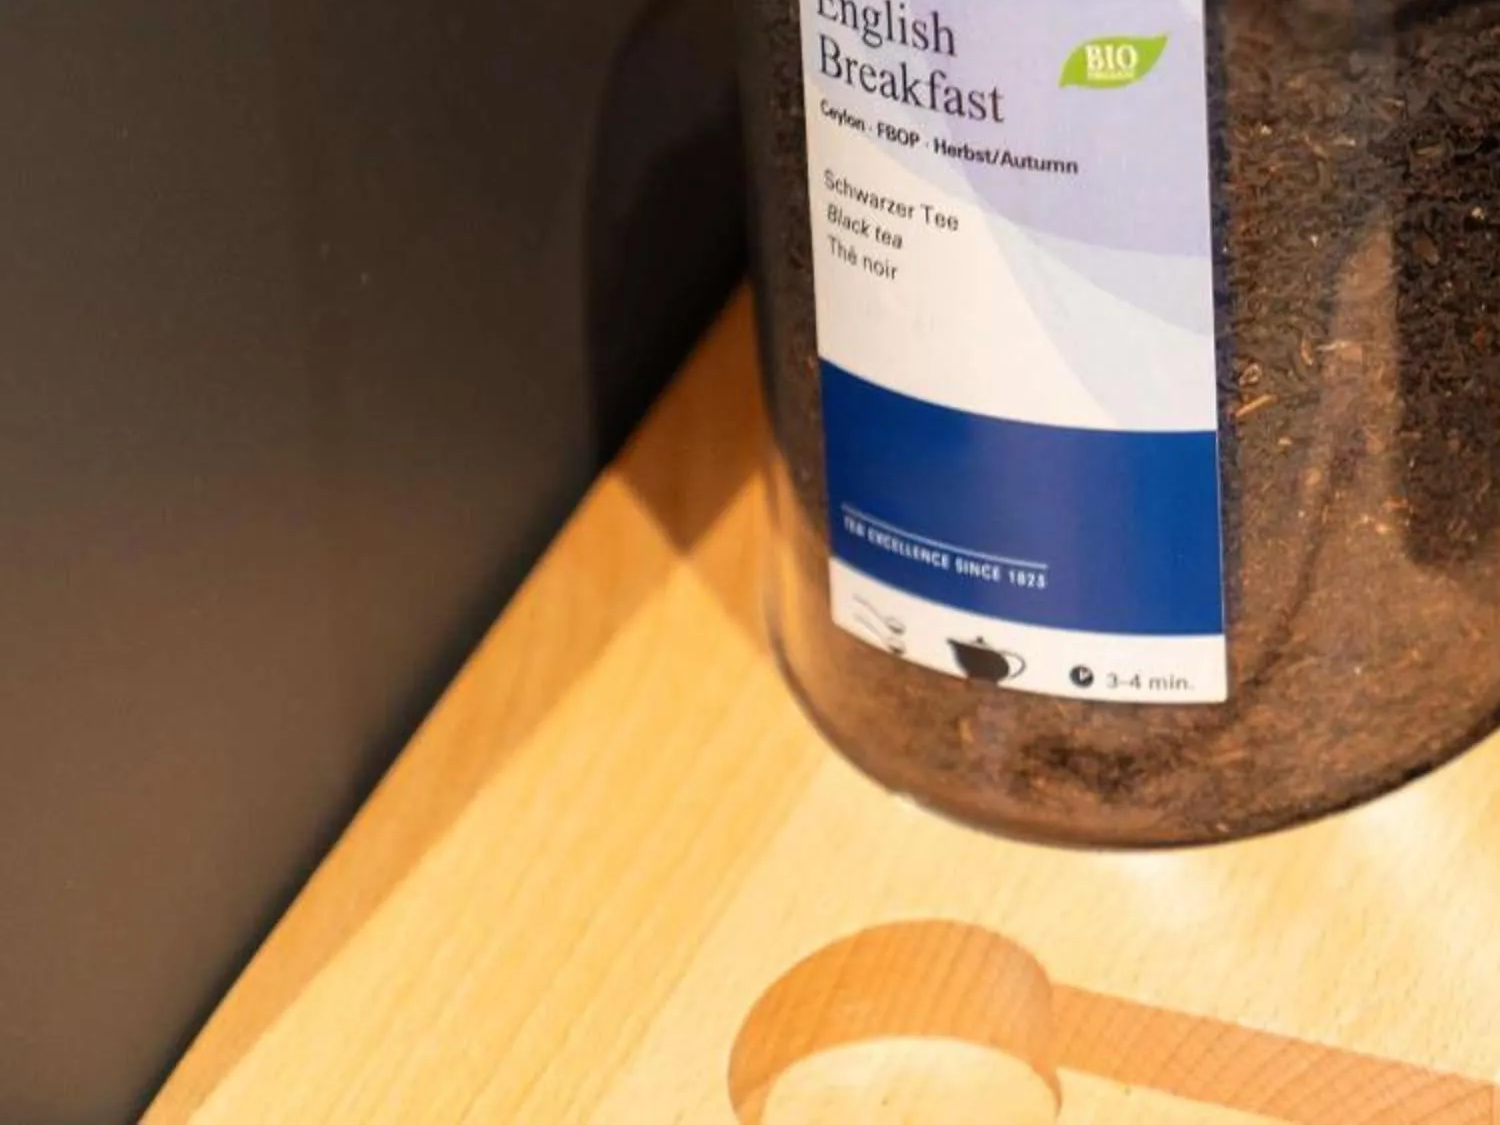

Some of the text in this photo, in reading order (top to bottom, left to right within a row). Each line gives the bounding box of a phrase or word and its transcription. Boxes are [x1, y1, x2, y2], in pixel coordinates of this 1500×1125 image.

[819, 33, 1005, 123] Breakfast
[1086, 45, 1138, 71] BIO
[820, 99, 1079, 174] Ceylon FBOP Herbst/Autumn
[823, 169, 960, 232] Schwarzer Tee
[827, 204, 904, 250] Black tea
[828, 235, 899, 281] Thé noir
[843, 515, 866, 537] TEA
[867, 529, 950, 571] EXCELLENCE
[955, 558, 1001, 582] SINCE
[1148, 675, 1194, 692] min.
